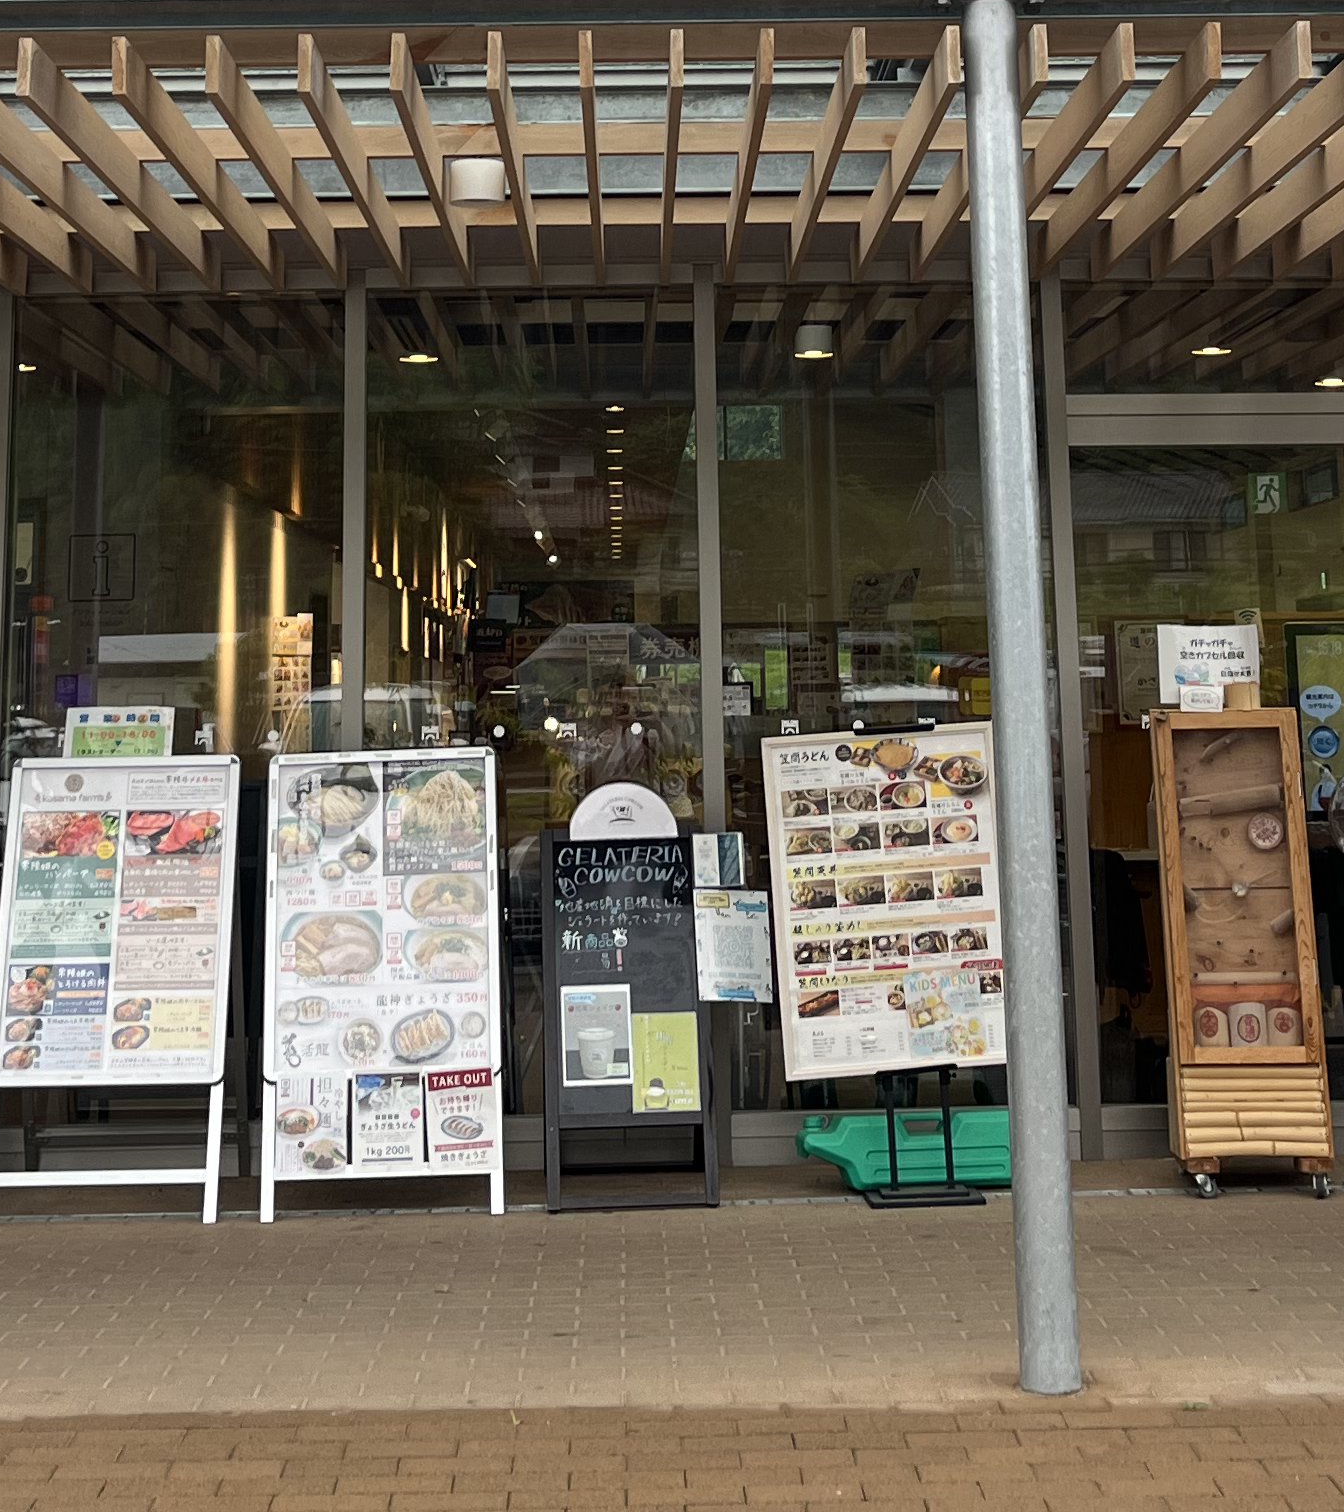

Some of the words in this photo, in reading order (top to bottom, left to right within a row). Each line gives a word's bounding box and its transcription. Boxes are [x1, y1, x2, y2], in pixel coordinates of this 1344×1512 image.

[558, 845, 683, 868] GELATERIA
[574, 865, 674, 885] COWCOW
[909, 978, 937, 993] KIDS
[939, 972, 976, 988] MENU
[431, 1075, 461, 1088] TAKE
[463, 1072, 487, 1085] OUT
[366, 1147, 382, 1157] 1kg
